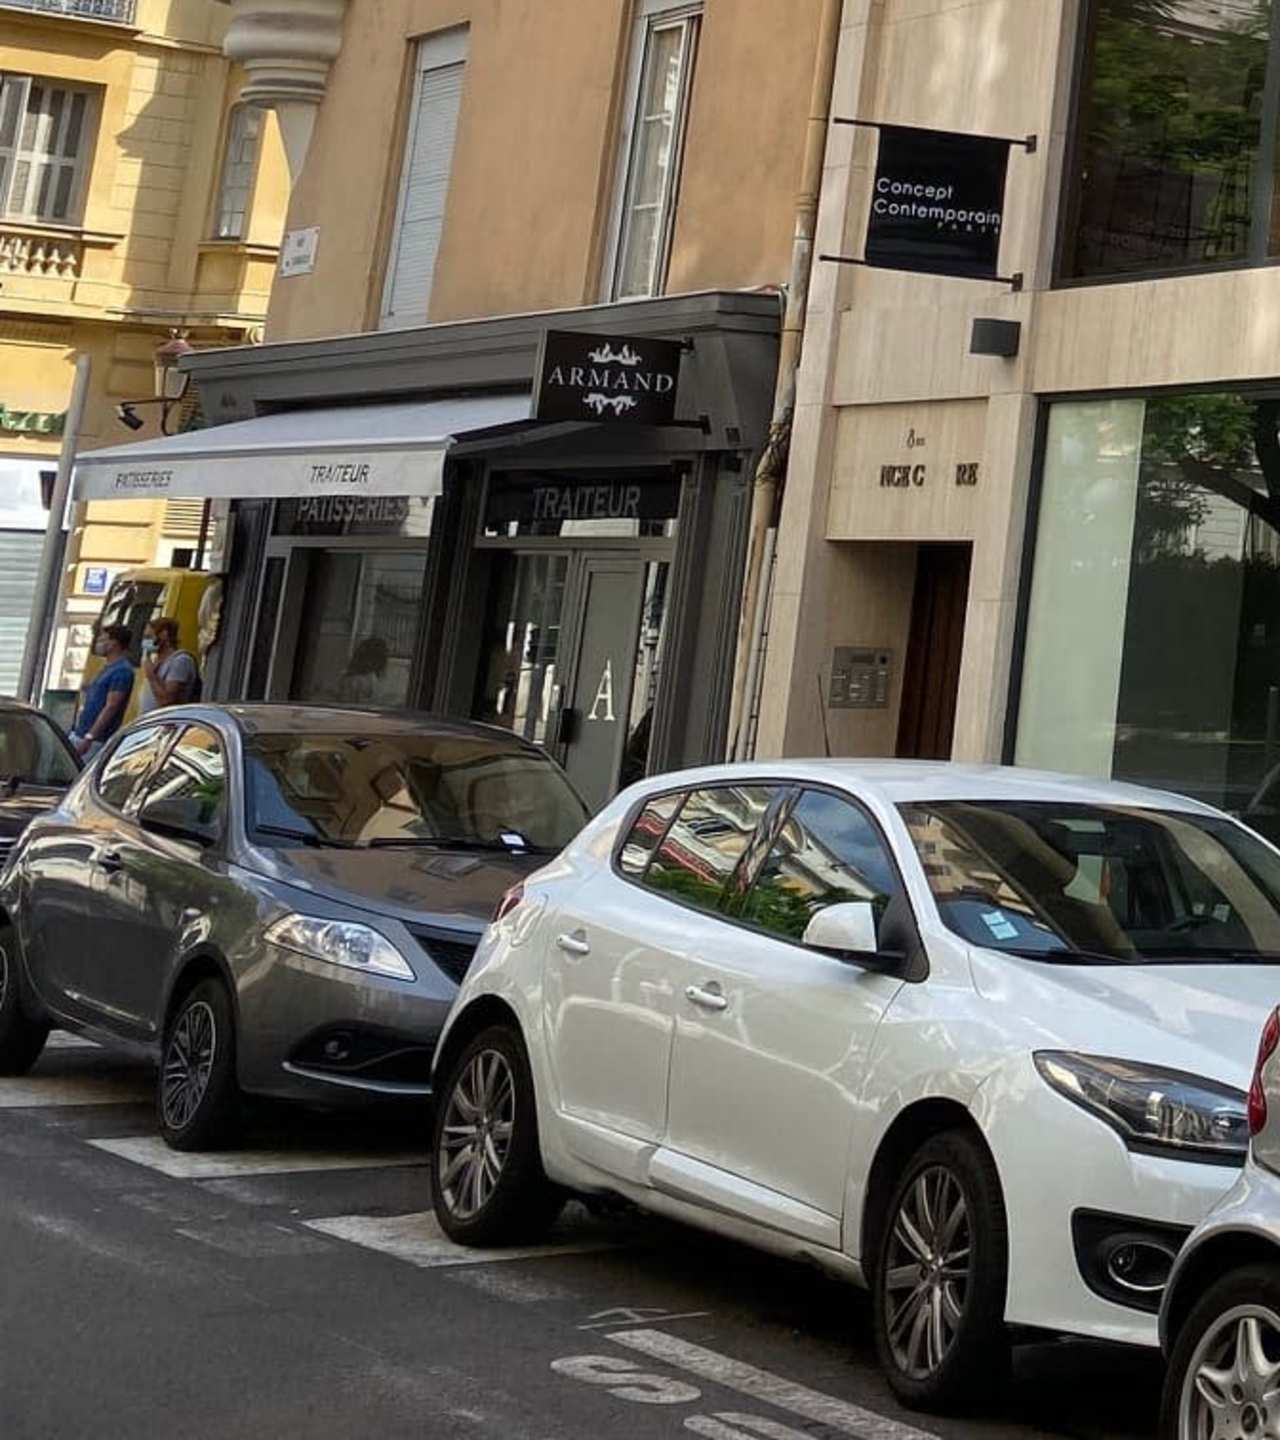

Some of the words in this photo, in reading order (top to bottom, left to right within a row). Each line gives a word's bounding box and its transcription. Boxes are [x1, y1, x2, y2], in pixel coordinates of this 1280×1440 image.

[876, 177, 953, 200] Concept
[873, 197, 1000, 224] Contemporain
[548, 365, 673, 393] ARMAND
[309, 464, 370, 485] TRAITEUR
[532, 484, 641, 519] TRAITEUR
[587, 659, 615, 720] A
